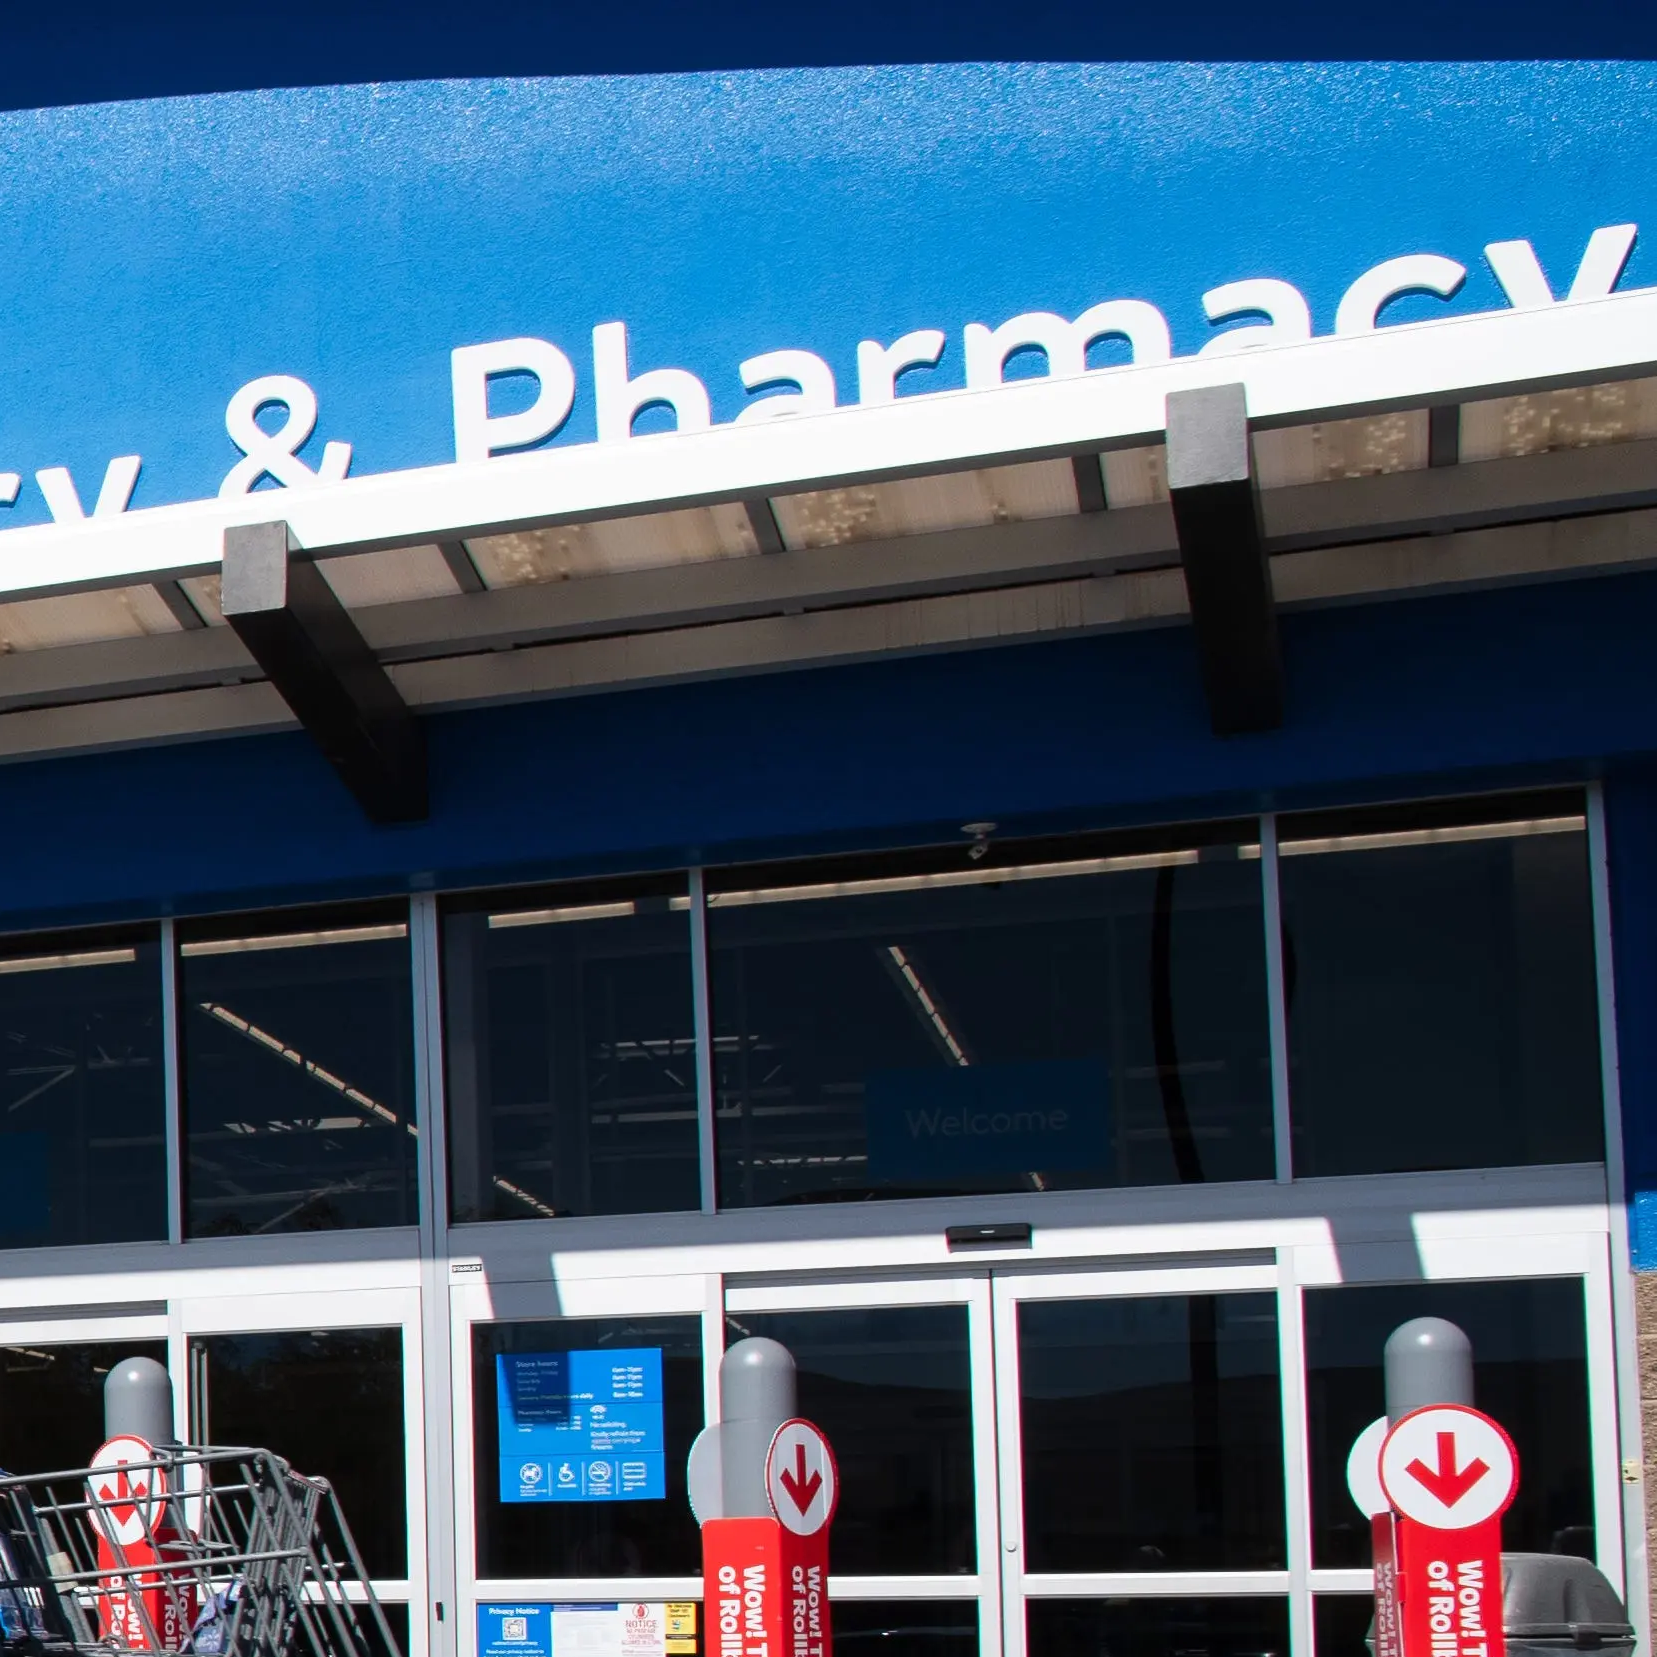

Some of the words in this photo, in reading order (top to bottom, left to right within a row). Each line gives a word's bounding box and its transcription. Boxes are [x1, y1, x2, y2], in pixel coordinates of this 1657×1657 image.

[217, 375, 353, 497] &
[903, 1106, 1069, 1139] Welcome
[719, 1566, 740, 1592] of
[743, 1565, 767, 1637] Wow!
[792, 1566, 806, 1591] of
[807, 1565, 822, 1637] Wow!
[1383, 1562, 1397, 1638] Wow!
[1427, 1560, 1456, 1592] of
[1457, 1560, 1486, 1638] Wow!
